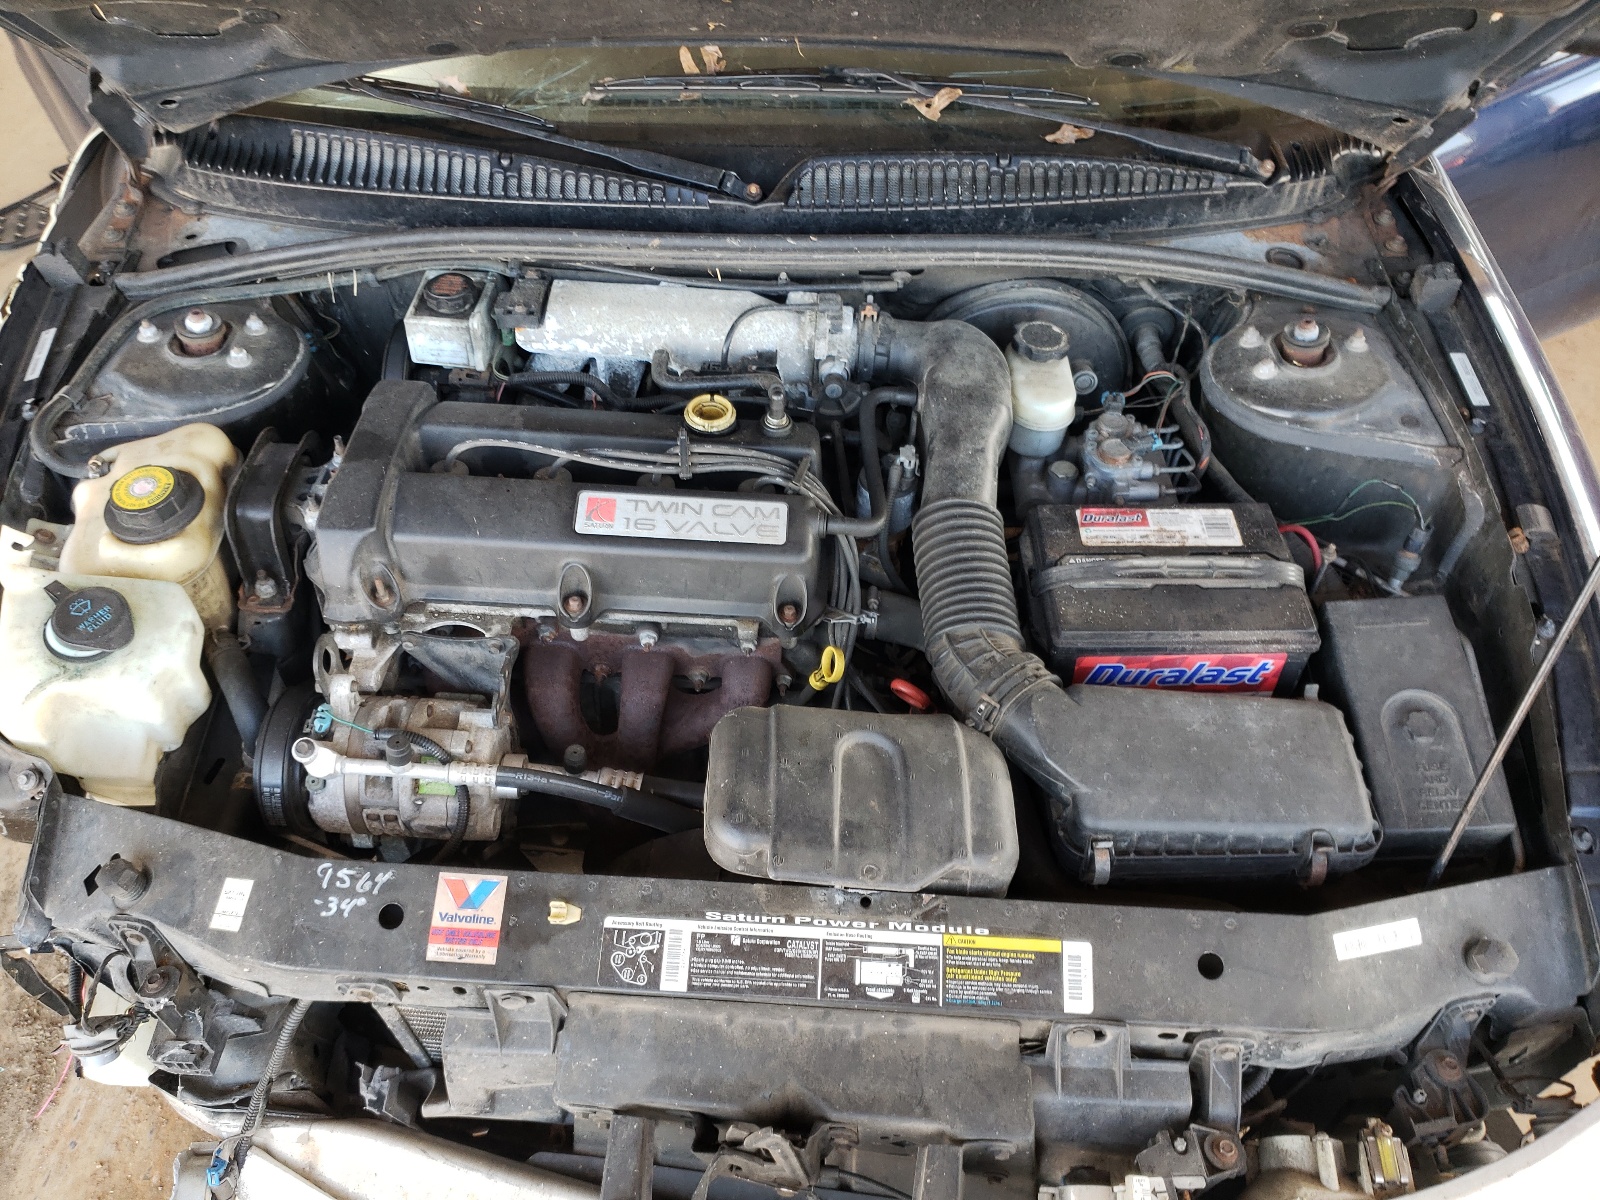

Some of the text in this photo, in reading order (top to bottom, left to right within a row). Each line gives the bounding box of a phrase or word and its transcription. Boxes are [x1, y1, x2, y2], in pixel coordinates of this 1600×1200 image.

[626, 500, 780, 520] TWIN CAM
[1082, 513, 1143, 524] Duralast
[624, 517, 779, 538] 16 VALVE
[76, 604, 112, 631] WASHER
[87, 614, 112, 632] FLUID
[1083, 661, 1275, 686] Duralast
[515, 773, 548, 784] R134a
[316, 862, 395, 895] 9564
[438, 912, 494, 924] Valvoline
[705, 911, 990, 936] Saturn Power Module
[787, 939, 819, 950] CATALYST
